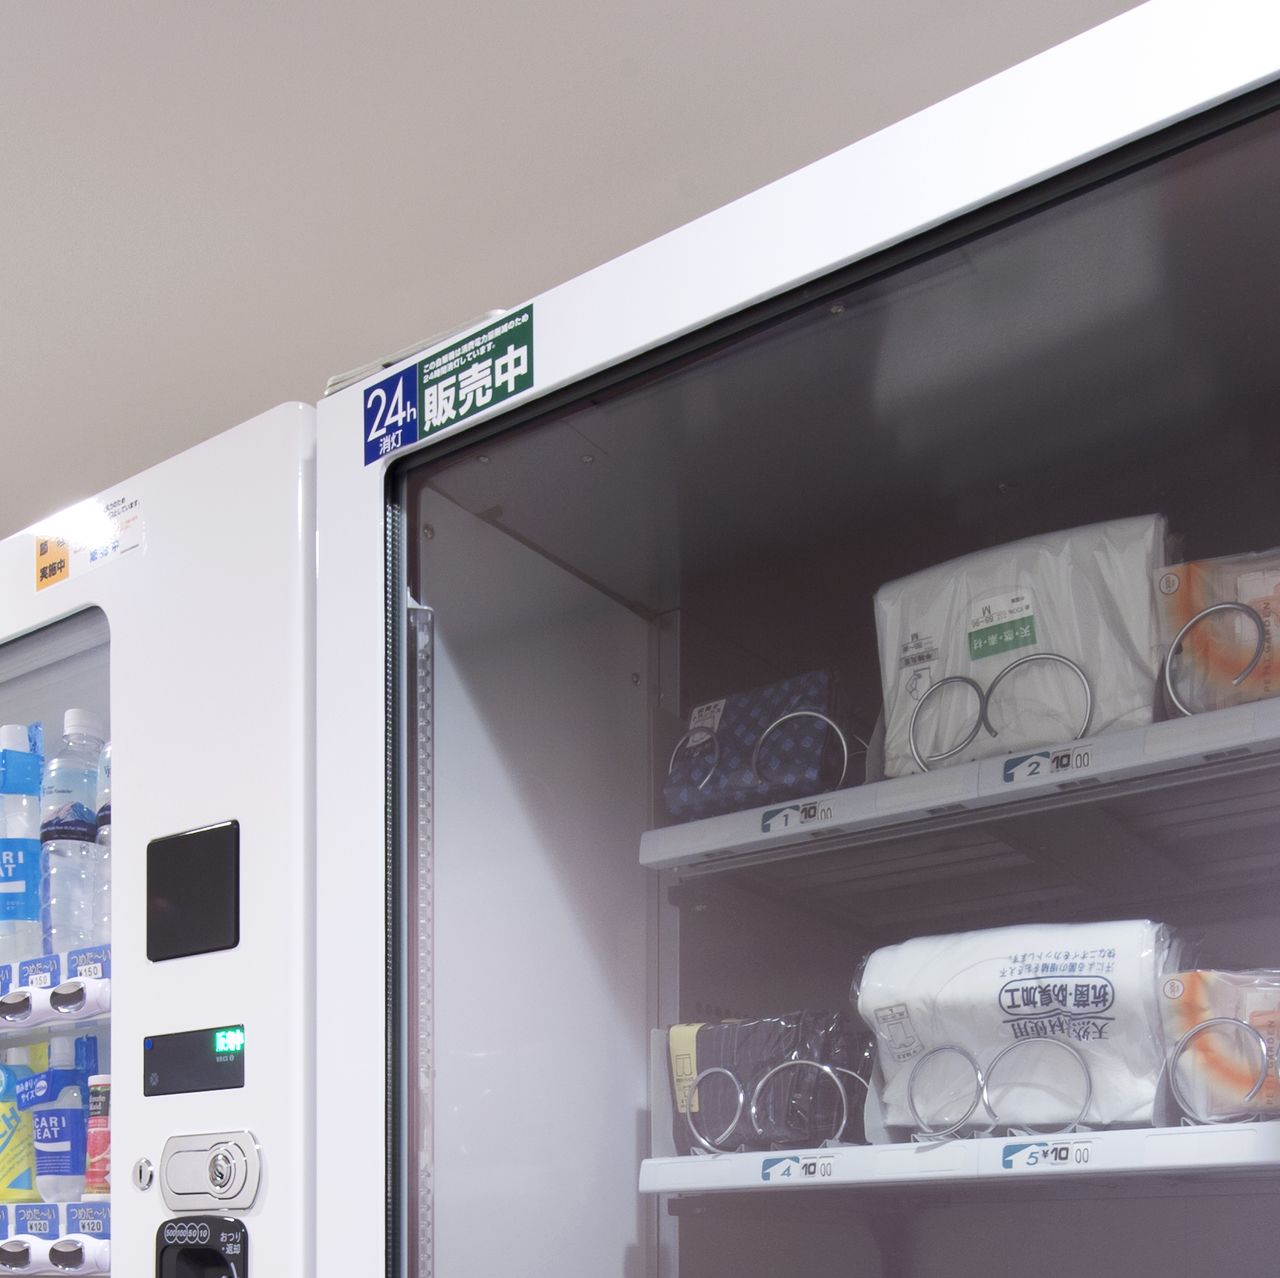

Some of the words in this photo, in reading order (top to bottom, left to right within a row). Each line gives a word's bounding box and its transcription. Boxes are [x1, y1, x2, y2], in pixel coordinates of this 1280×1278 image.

[424, 344, 528, 432] 販売中
[367, 376, 417, 442] 24h
[379, 429, 403, 455] 消灯
[39, 558, 65, 582] 実施中
[1027, 761, 1041, 776] 2
[1004, 982, 1110, 1010] 抗菌・防臭加工
[1026, 1151, 1041, 1166] 5
[780, 1165, 793, 1178] 4
[29, 1221, 48, 1232] ¥120
[81, 1220, 102, 1232] ¥120
[220, 1231, 241, 1243] おつり
